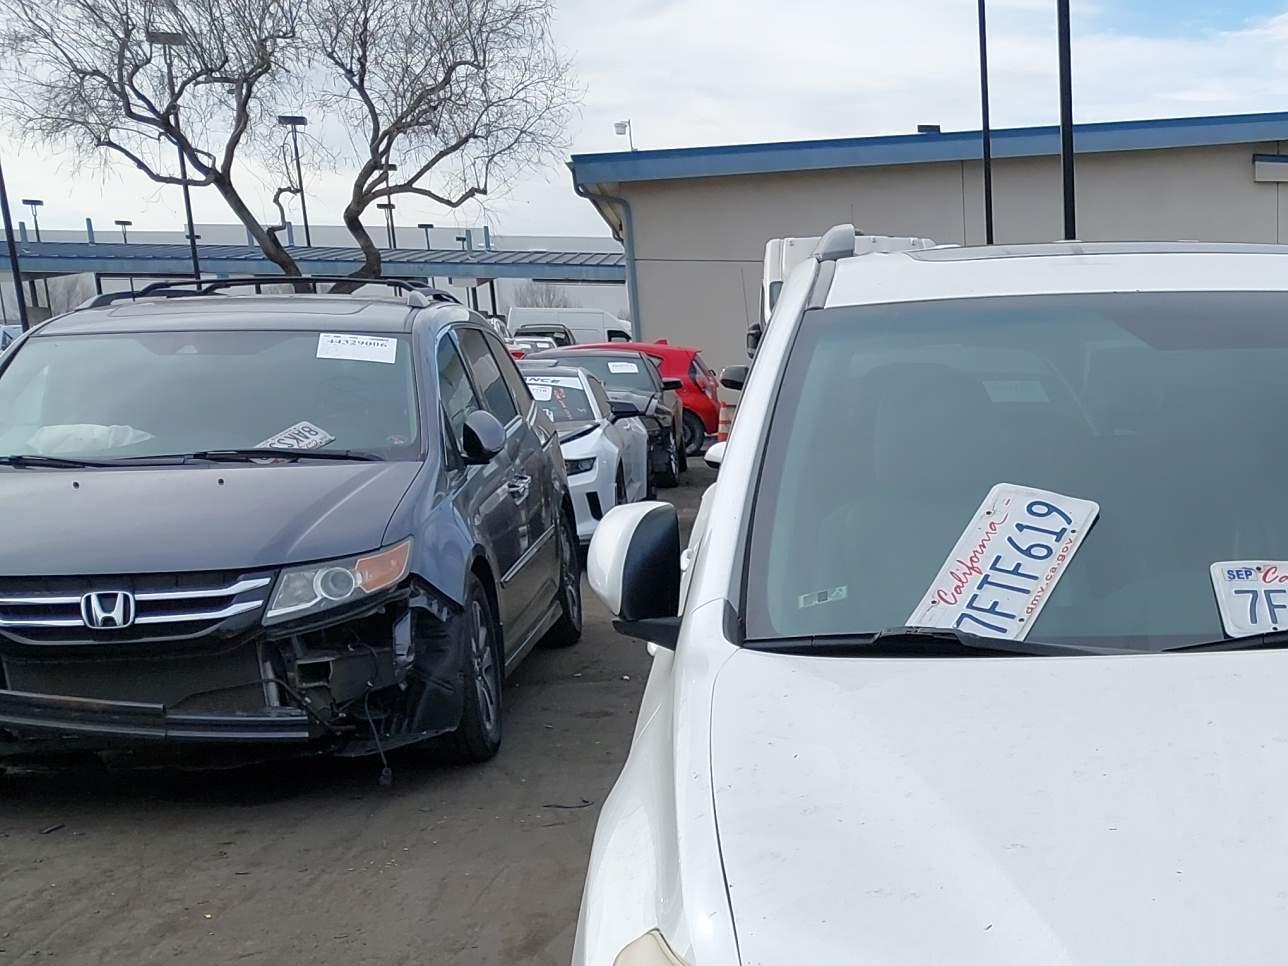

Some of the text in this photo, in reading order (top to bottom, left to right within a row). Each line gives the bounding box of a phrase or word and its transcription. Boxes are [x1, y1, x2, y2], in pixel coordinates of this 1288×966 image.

[936, 512, 1009, 606] California
[956, 500, 1073, 634] 7FTF619
[1026, 538, 1073, 615] dmv.ca.gov
[1226, 568, 1253, 581] SEP
